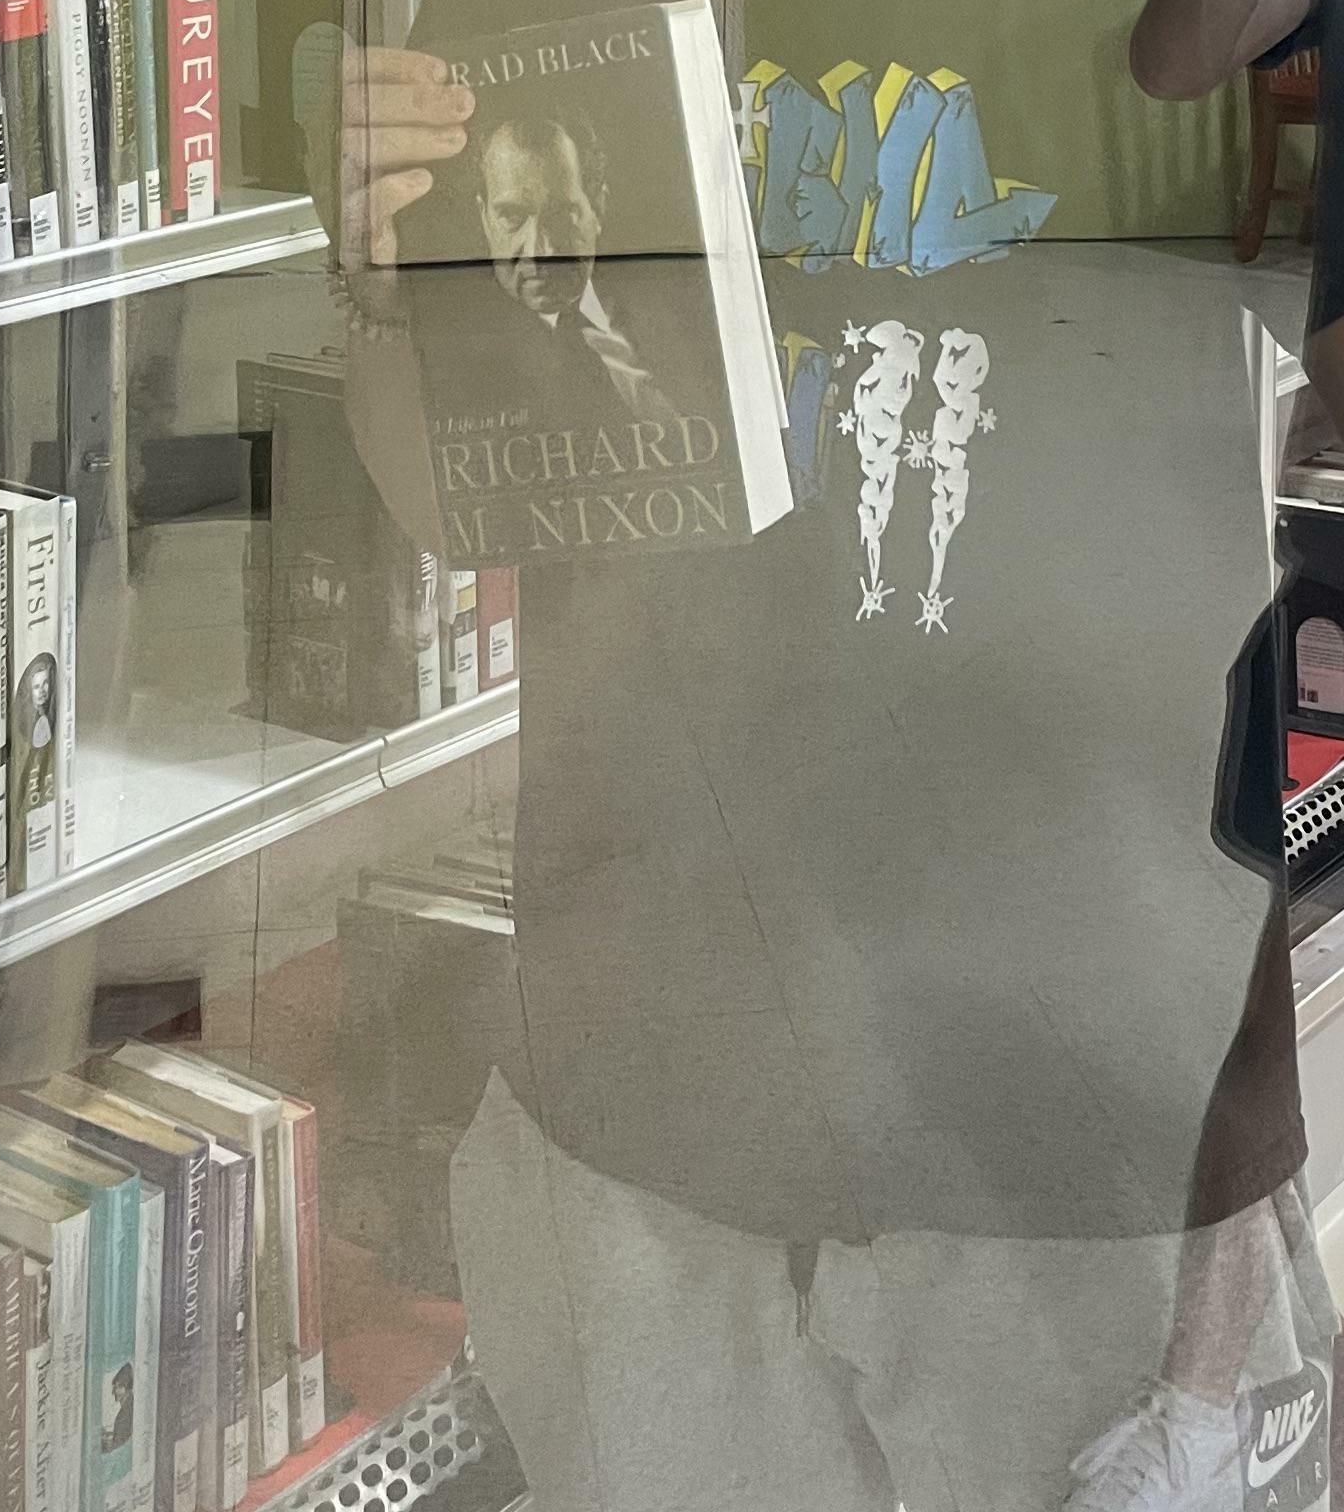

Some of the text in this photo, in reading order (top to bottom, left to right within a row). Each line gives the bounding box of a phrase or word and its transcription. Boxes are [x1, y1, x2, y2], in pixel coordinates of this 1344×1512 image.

[72, 13, 86, 78] PEGGY
[536, 30, 652, 75] BLACK
[77, 88, 92, 183] NOONAN
[437, 414, 720, 492] RICHARD
[449, 413, 482, 435] Life
[450, 483, 730, 557] M. NIXON
[27, 529, 54, 631] First
[29, 764, 41, 805] THO
[184, 1156, 207, 1339] Marie Osmond
[35, 1358, 51, 1500] Jackie After
[1258, 1389, 1315, 1452] NIKE
